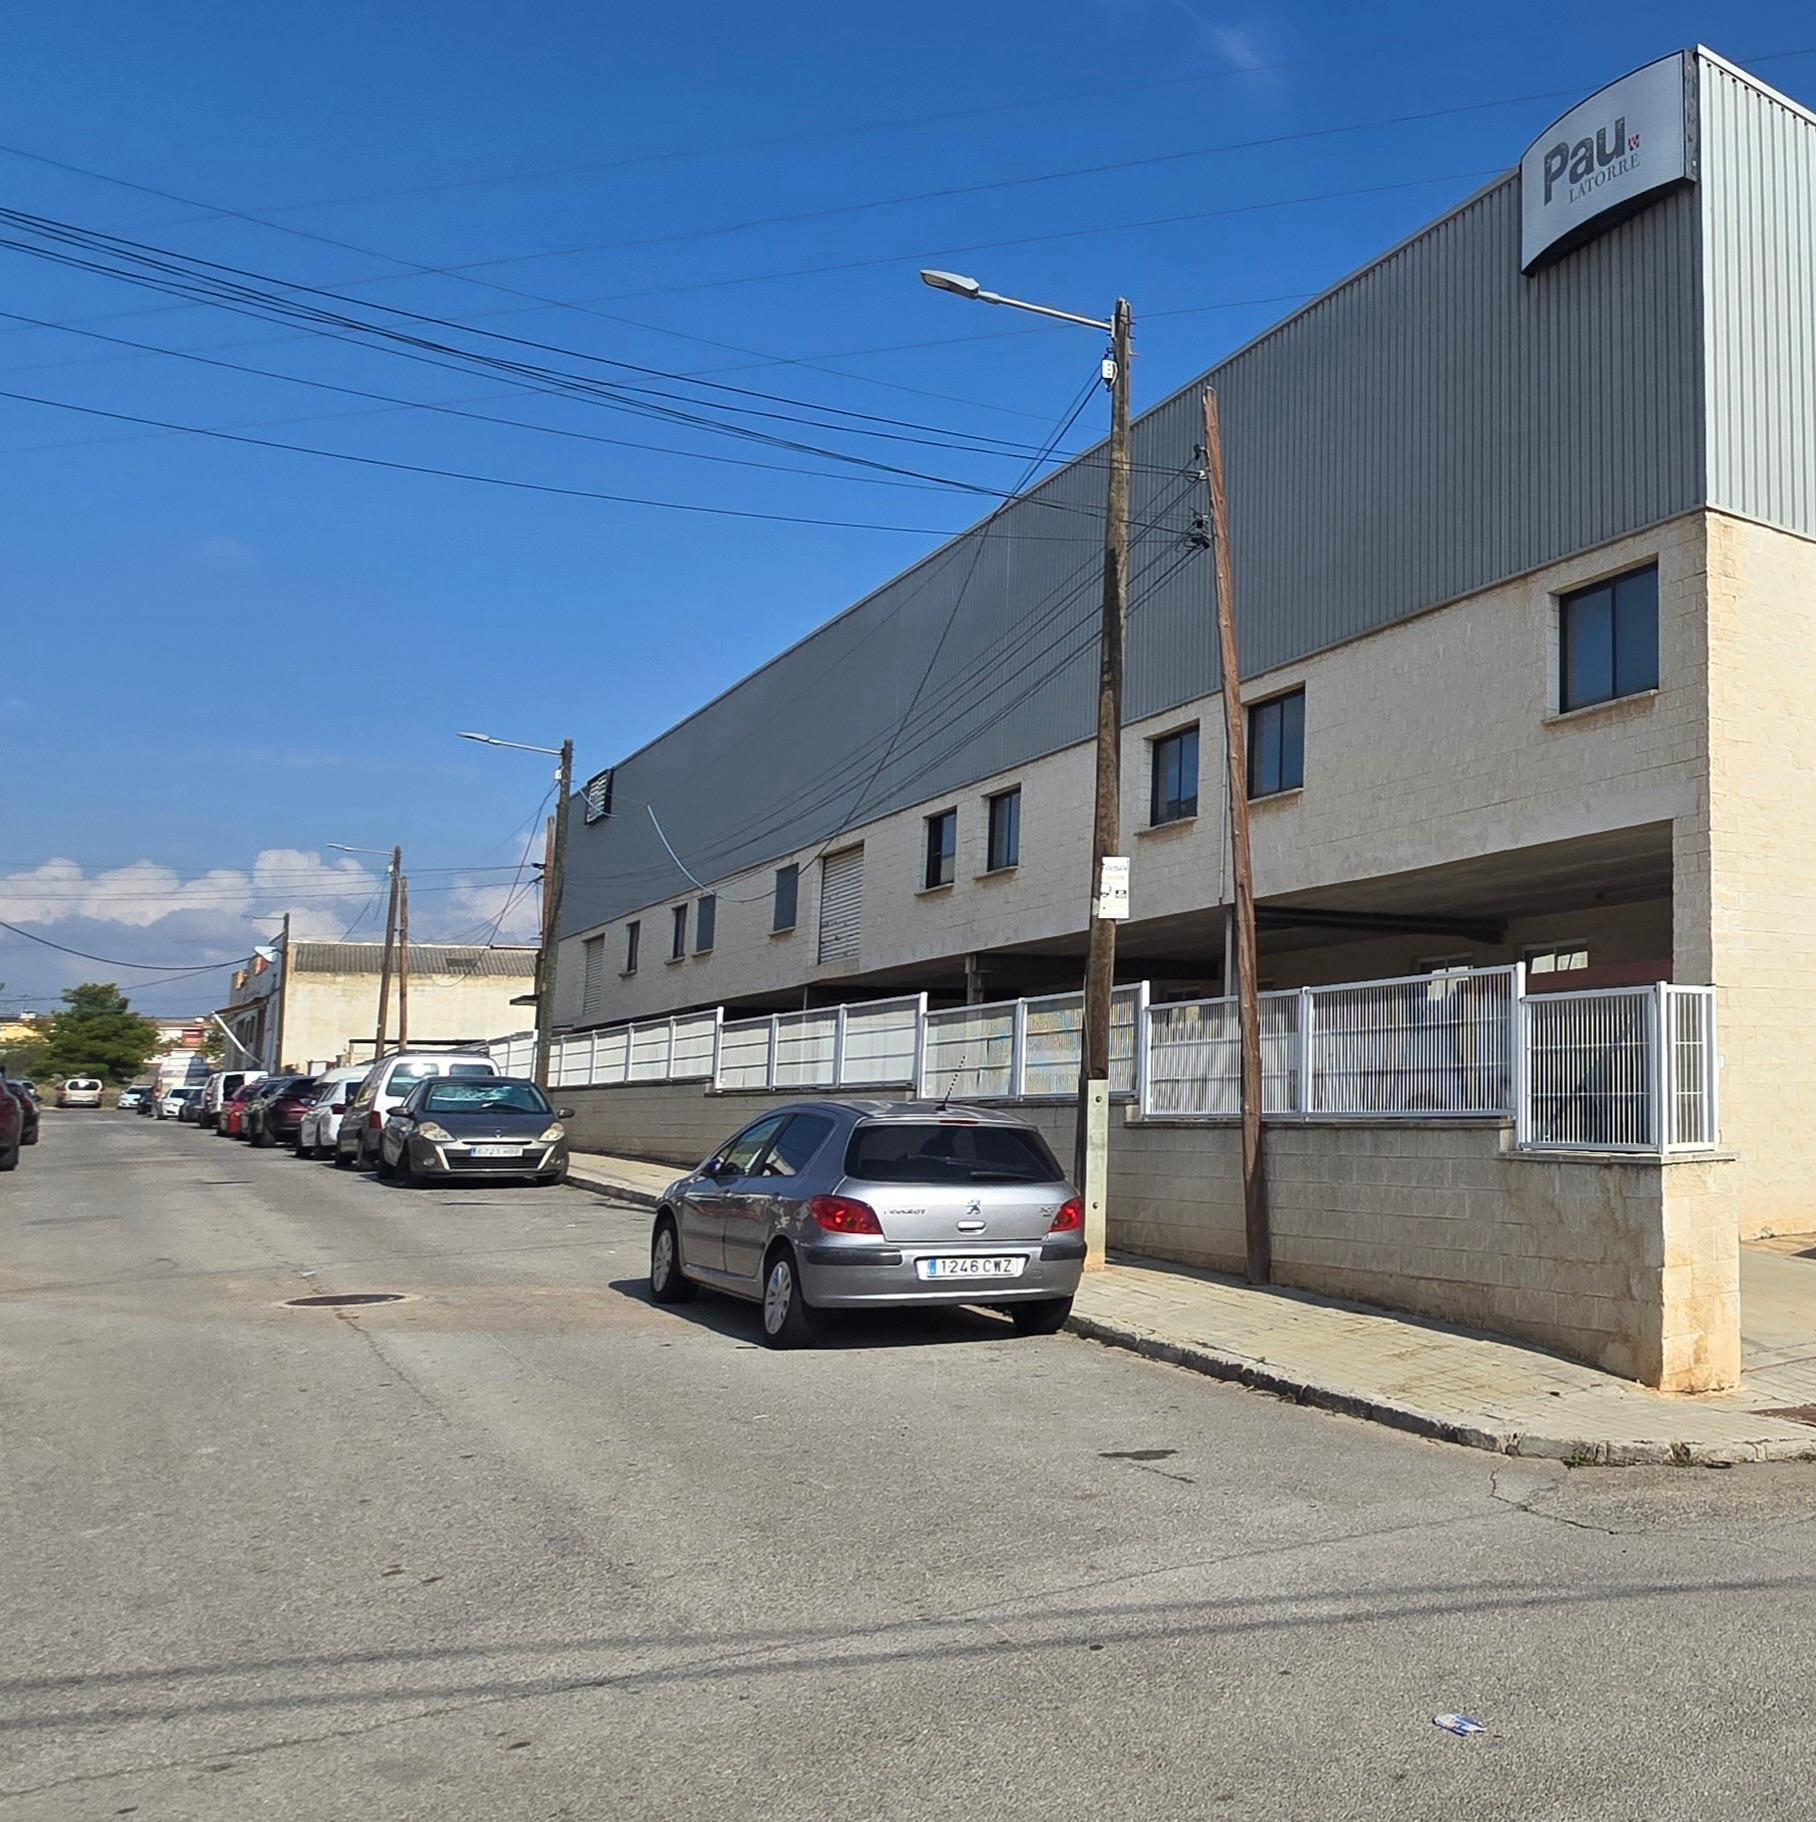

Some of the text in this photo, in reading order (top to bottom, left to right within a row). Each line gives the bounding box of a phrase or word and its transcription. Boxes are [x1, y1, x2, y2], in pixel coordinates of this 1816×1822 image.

[1544, 116, 1626, 206] Pau
[1569, 153, 1641, 203] LATORRE
[941, 1258, 1012, 1274] 1246 CWZ
